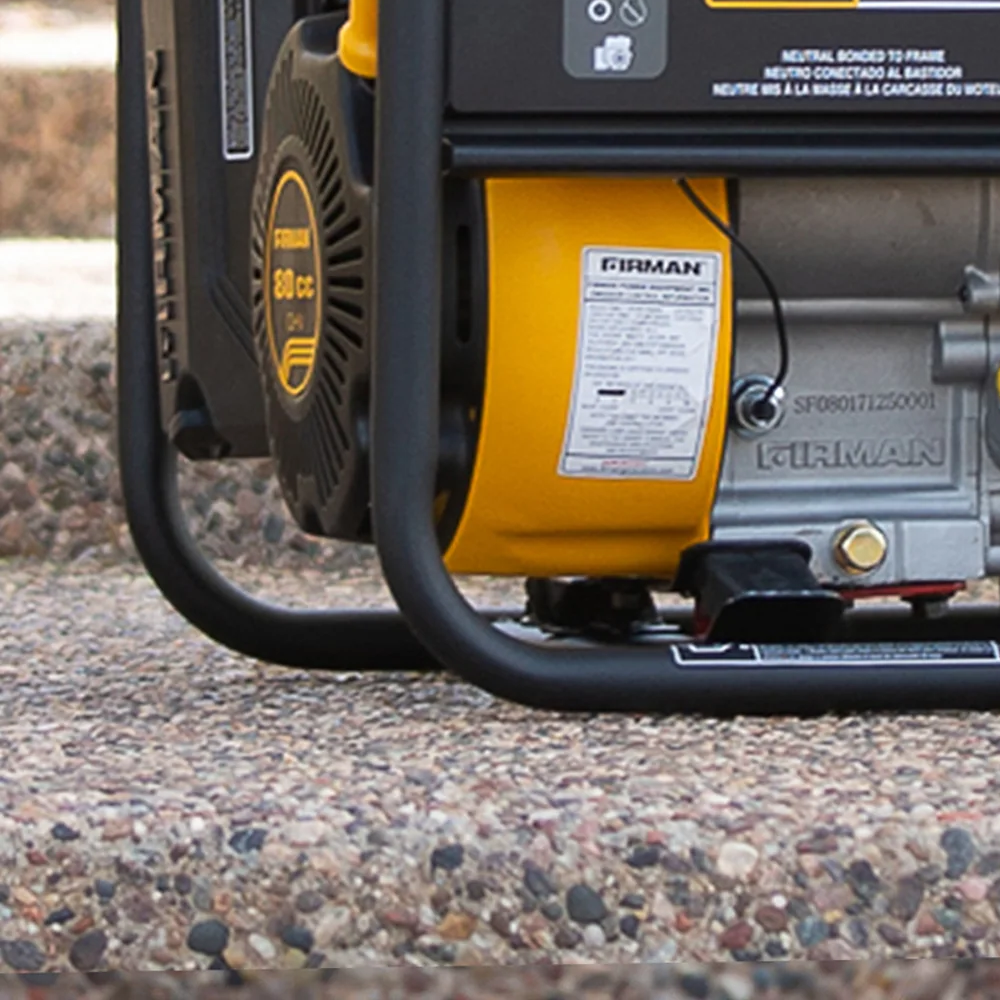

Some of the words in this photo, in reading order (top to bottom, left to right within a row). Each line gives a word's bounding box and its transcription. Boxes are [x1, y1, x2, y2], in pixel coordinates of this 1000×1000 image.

[887, 67, 902, 79] AL
[602, 257, 702, 276] FIRMAN
[274, 268, 295, 300] 80
[757, 438, 946, 471] FIRMAN
